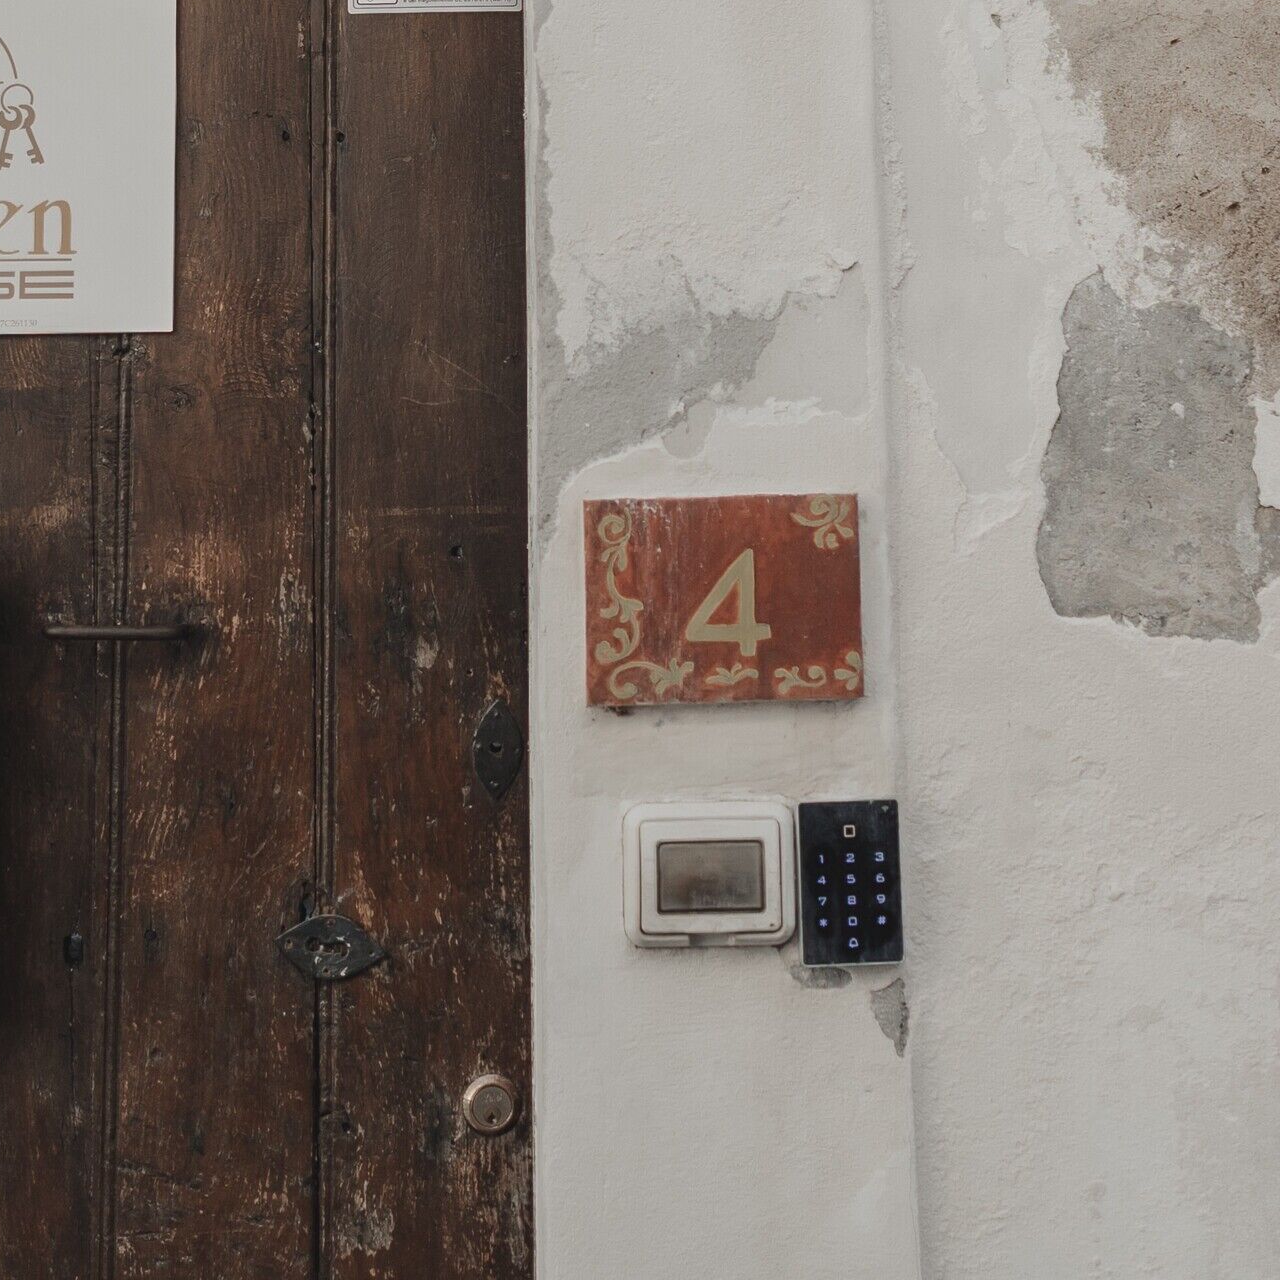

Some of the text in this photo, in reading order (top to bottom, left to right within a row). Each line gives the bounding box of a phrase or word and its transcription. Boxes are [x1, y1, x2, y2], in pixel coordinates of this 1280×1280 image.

[685, 548, 771, 657] 4
[819, 851, 884, 864] 1 2 3
[817, 872, 885, 885] 4 5 6
[818, 893, 886, 906] 7 8 9
[848, 916, 858, 927] 0
